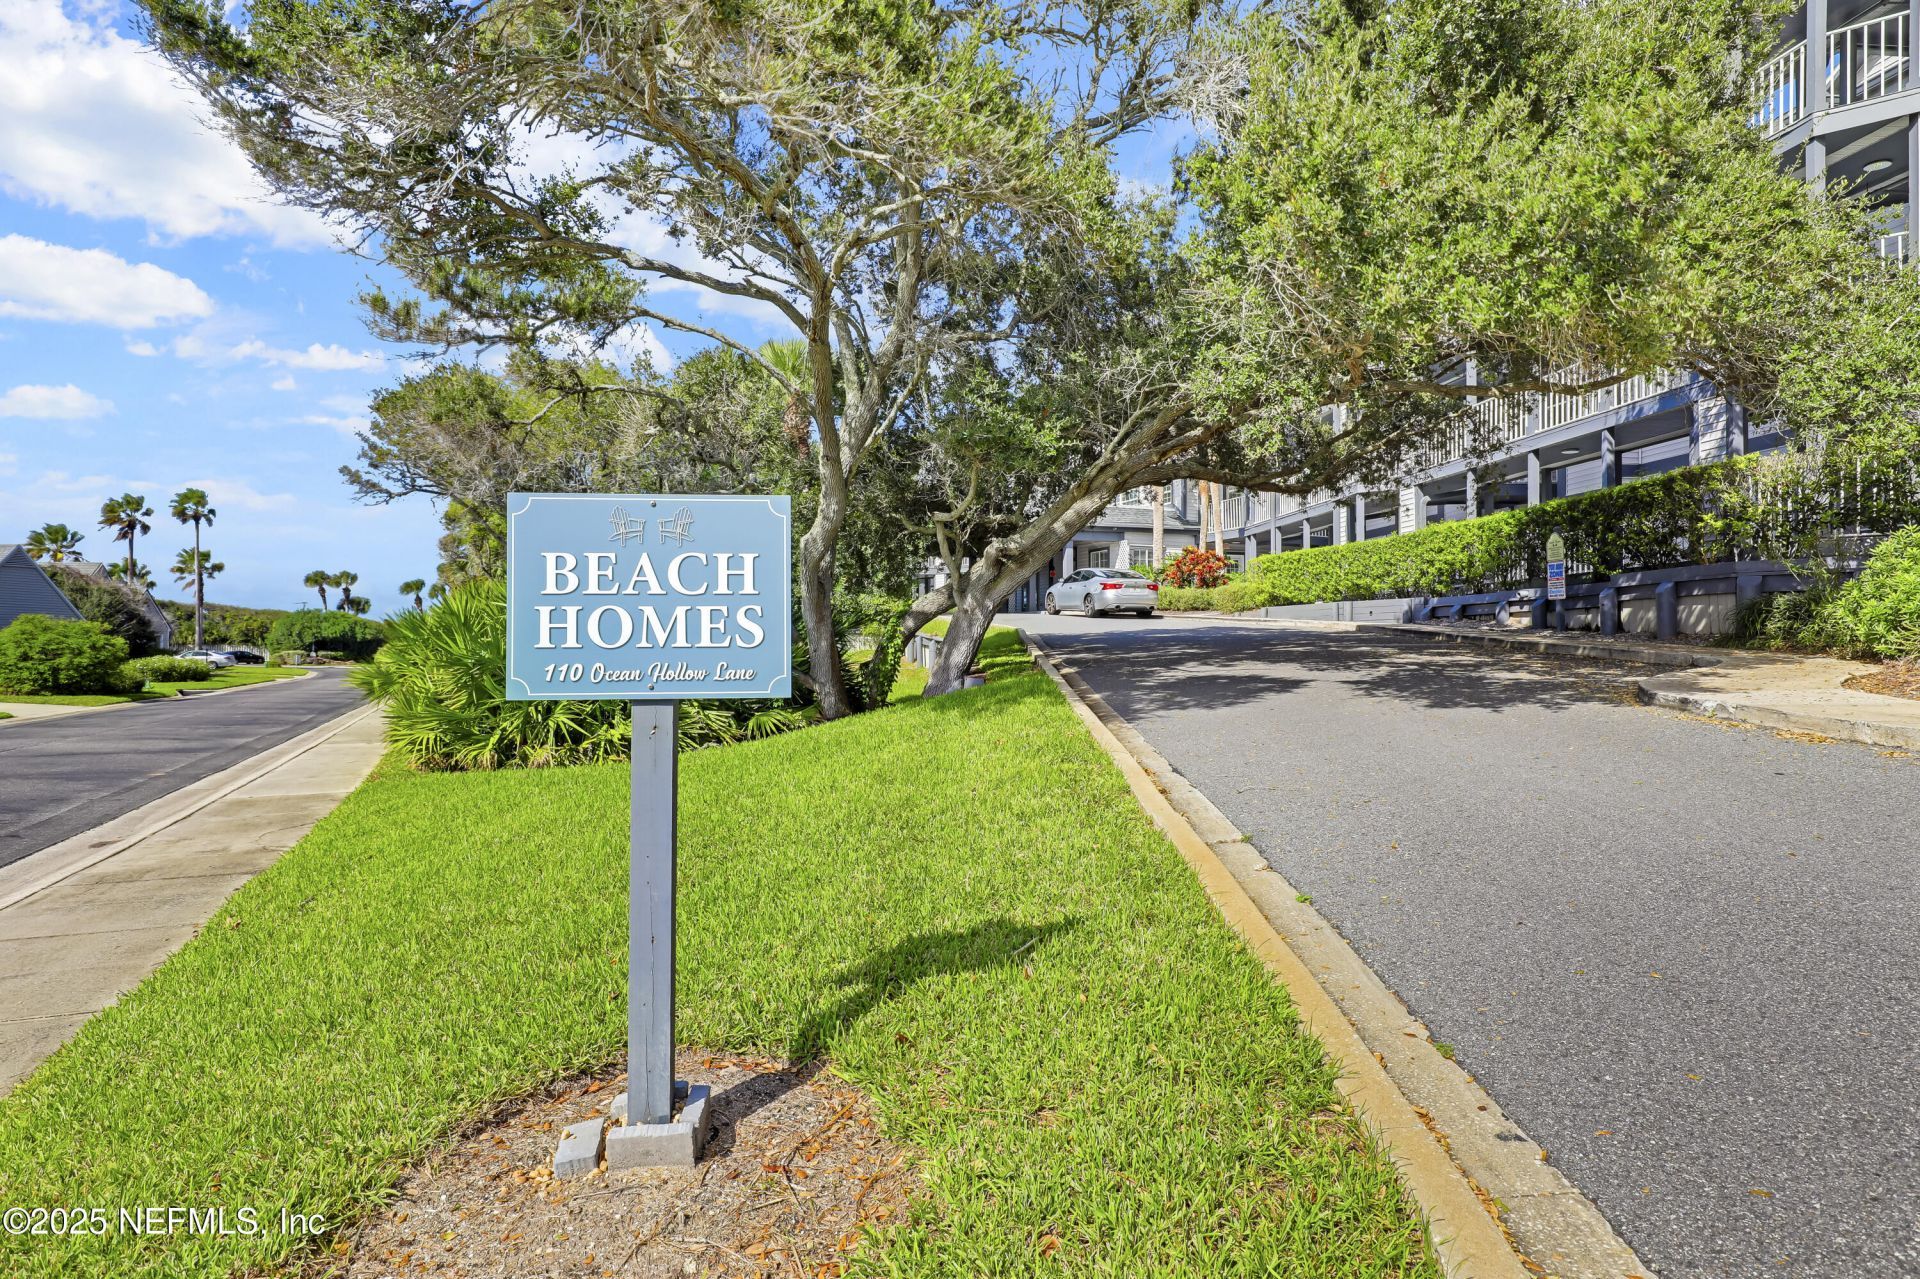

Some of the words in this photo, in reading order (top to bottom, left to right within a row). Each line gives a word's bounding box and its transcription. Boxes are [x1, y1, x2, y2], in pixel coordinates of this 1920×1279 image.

[540, 552, 760, 596] BEACH
[534, 605, 765, 649] HOMES
[544, 663, 584, 683] 110
[590, 663, 644, 684] Ocean
[647, 662, 709, 683] Hollow
[713, 662, 756, 681] Lane
